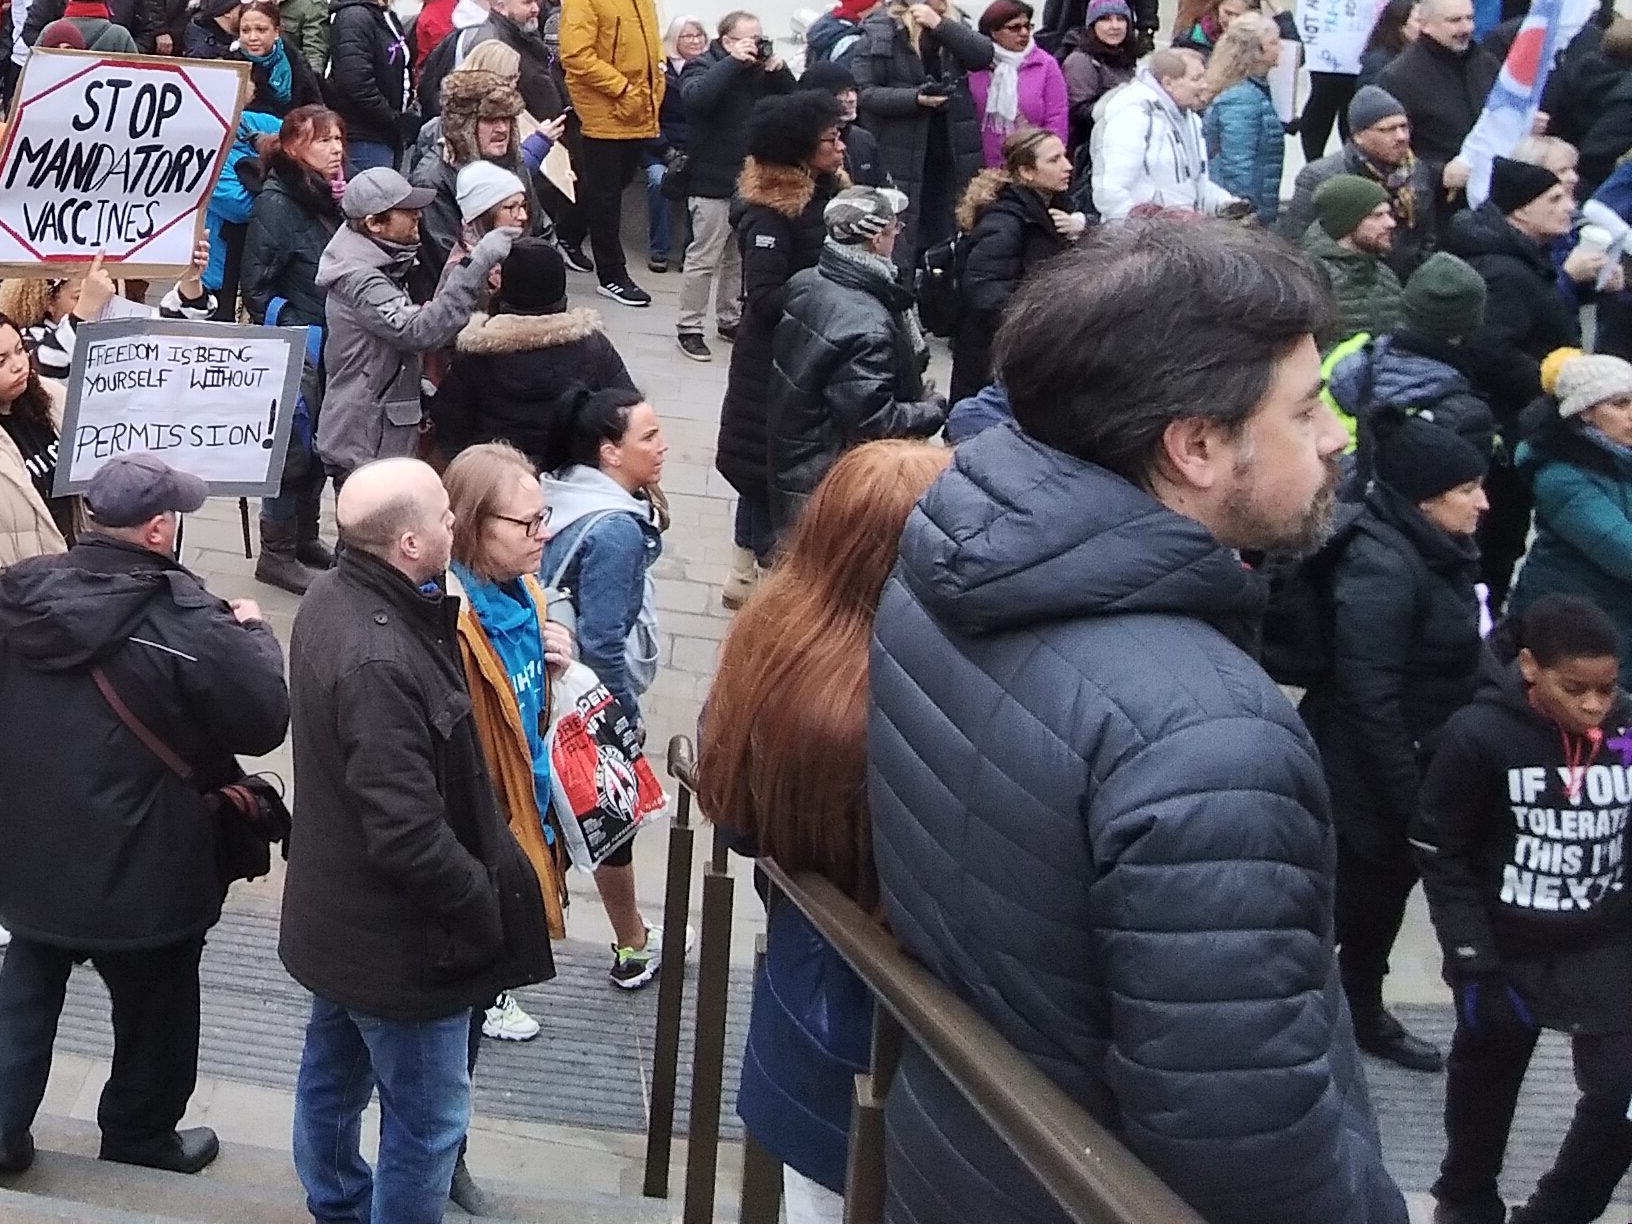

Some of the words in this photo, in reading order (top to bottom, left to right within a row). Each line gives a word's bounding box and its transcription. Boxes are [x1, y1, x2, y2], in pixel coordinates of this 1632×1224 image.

[72, 78, 183, 139] STOP
[5, 136, 216, 198] MANDATORY
[23, 197, 160, 247] VACCINES
[87, 343, 159, 369] FREEDOM
[168, 345, 192, 366] IS
[193, 345, 254, 363] BEING
[85, 368, 173, 397] YOURSELF
[190, 365, 270, 390] WITHOUT
[76, 398, 277, 463] PERMISSION!
[1507, 766, 1547, 804] IF
[1557, 764, 1632, 806] YOU
[1514, 833, 1584, 875] THIS
